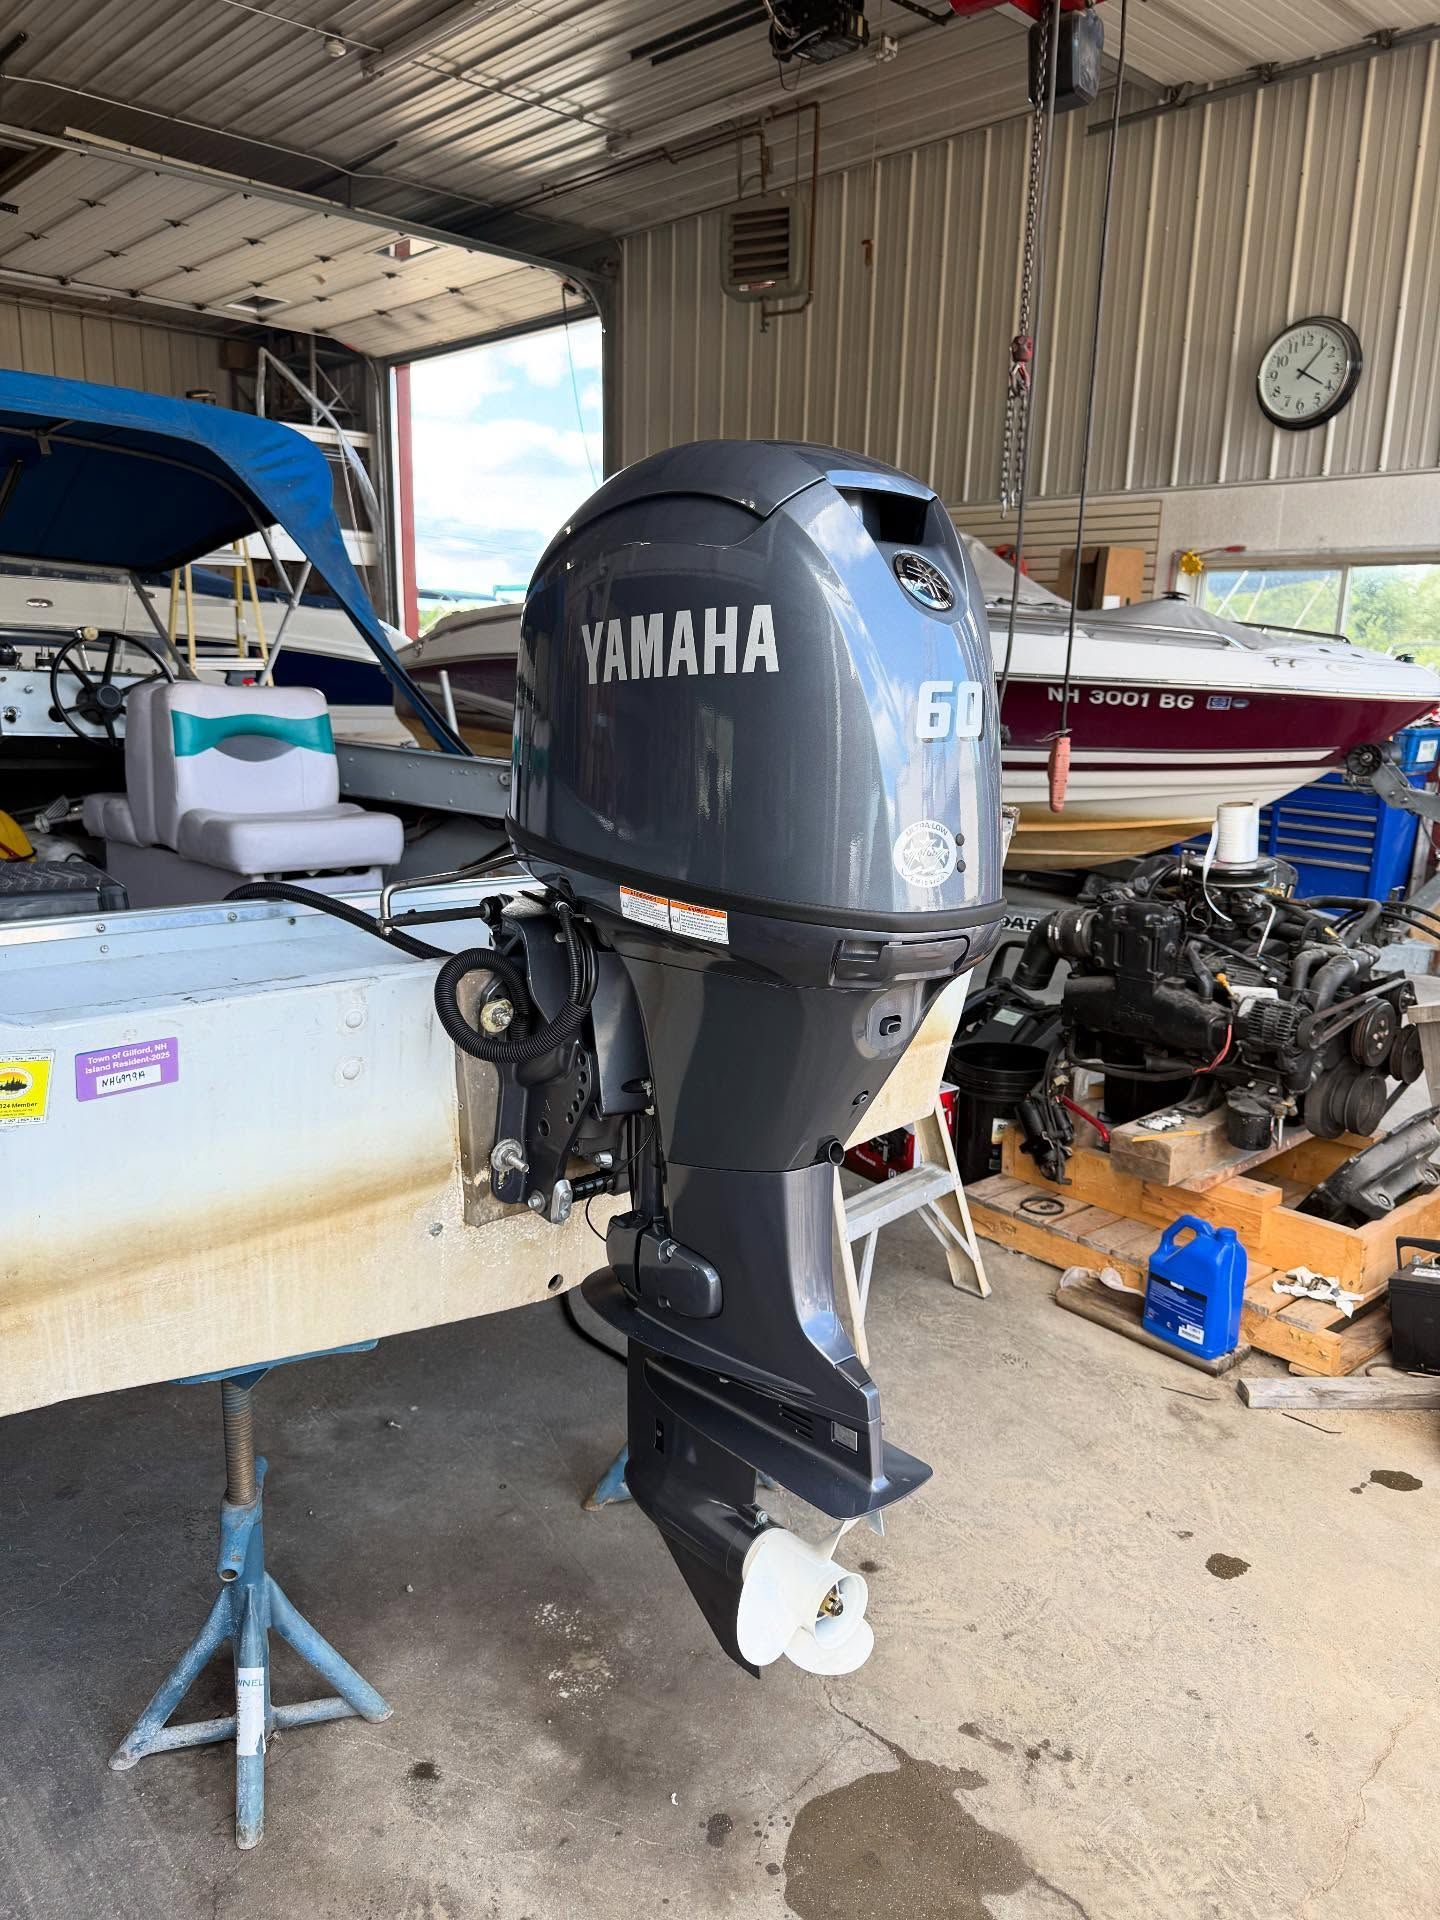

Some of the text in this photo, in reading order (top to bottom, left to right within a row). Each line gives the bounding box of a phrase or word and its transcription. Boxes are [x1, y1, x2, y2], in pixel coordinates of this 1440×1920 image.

[581, 604, 780, 685] YAMAHA
[915, 680, 983, 740] 60
[1047, 687, 1080, 704] NH
[1089, 689, 1150, 708] 3001
[1159, 693, 1195, 710] BG
[85, 1051, 170, 1074] Island Resident-2025
[88, 1042, 168, 1065] Town of Gilford, NH
